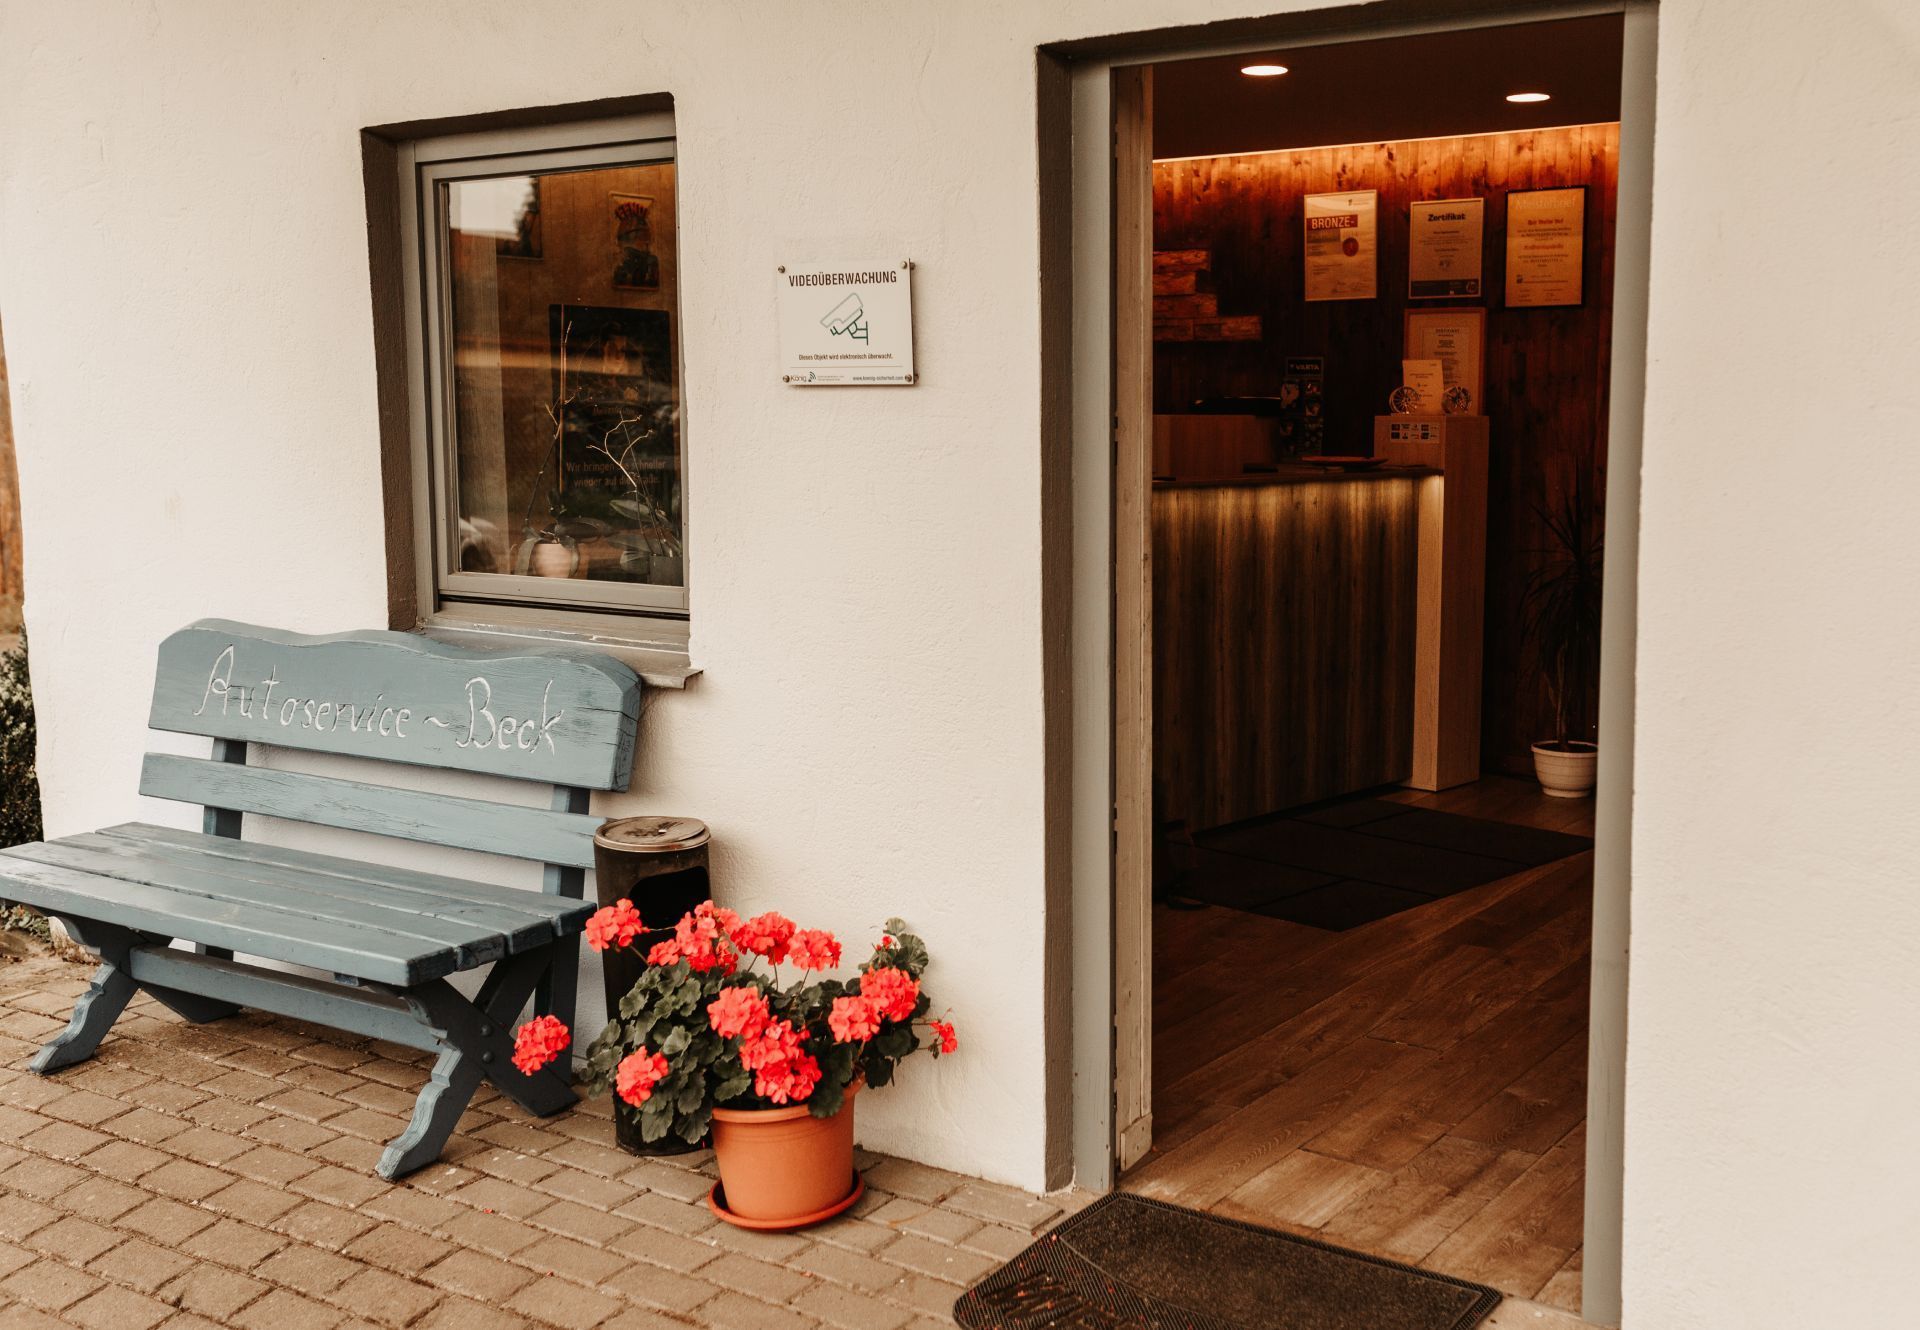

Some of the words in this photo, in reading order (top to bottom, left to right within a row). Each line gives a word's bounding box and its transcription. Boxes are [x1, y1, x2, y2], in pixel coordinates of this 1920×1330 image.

[1311, 216, 1355, 229] BRONZE-
[1427, 212, 1466, 222] Zertifikat
[788, 270, 897, 287] VIDEOÜBERWACHUNG
[814, 353, 828, 362] Objekt
[193, 643, 412, 739] Autoservice
[454, 675, 564, 756] Beck
